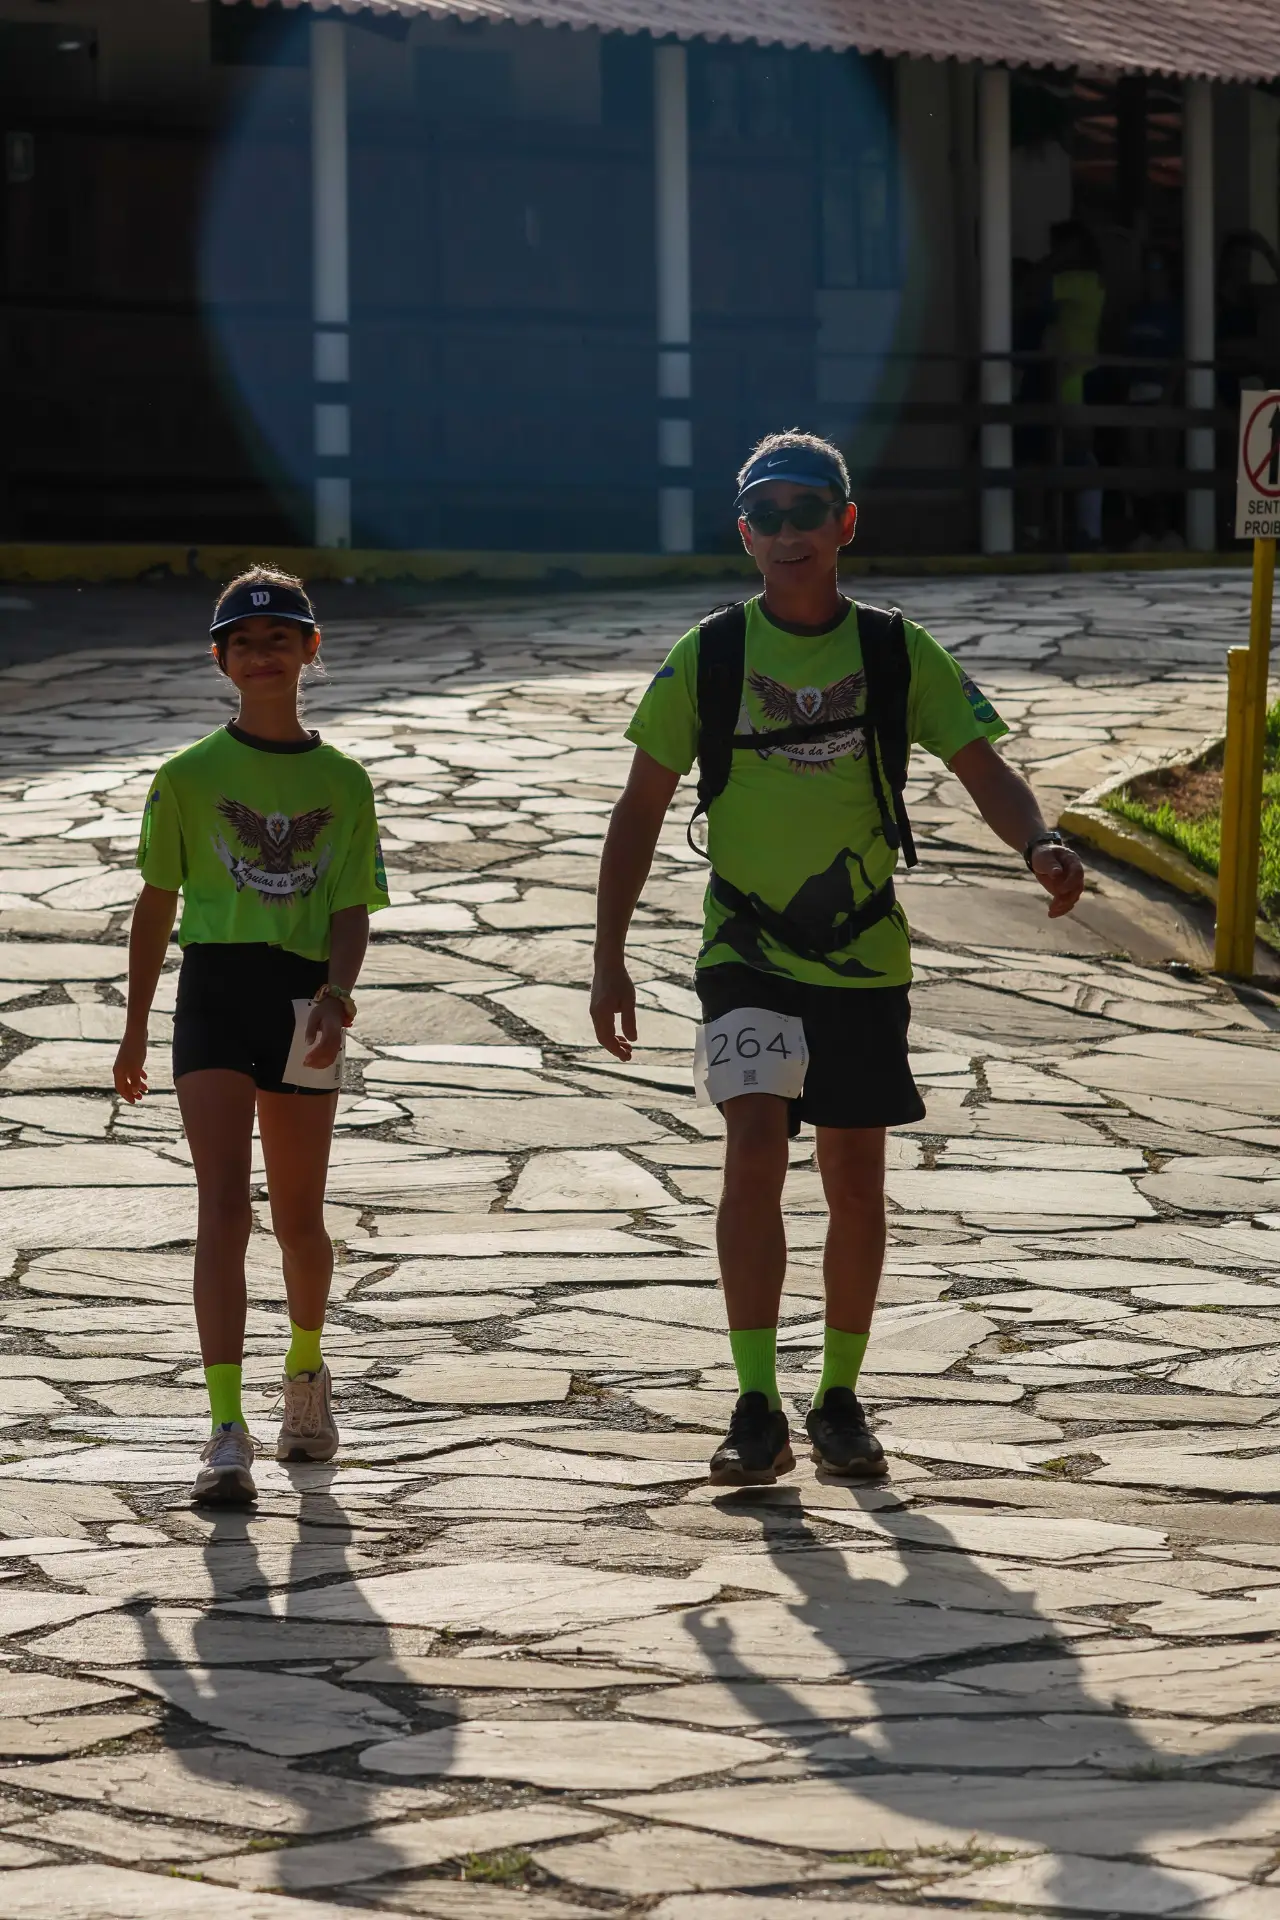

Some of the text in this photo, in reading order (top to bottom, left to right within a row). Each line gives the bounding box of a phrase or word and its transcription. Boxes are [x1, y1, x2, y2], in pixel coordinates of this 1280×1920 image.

[1248, 500, 1280, 515] SENT
[1244, 521, 1280, 535] PROIB
[250, 591, 271, 606] W
[808, 746, 824, 756] da
[827, 737, 858, 755] Serra
[710, 1026, 792, 1067] 264
